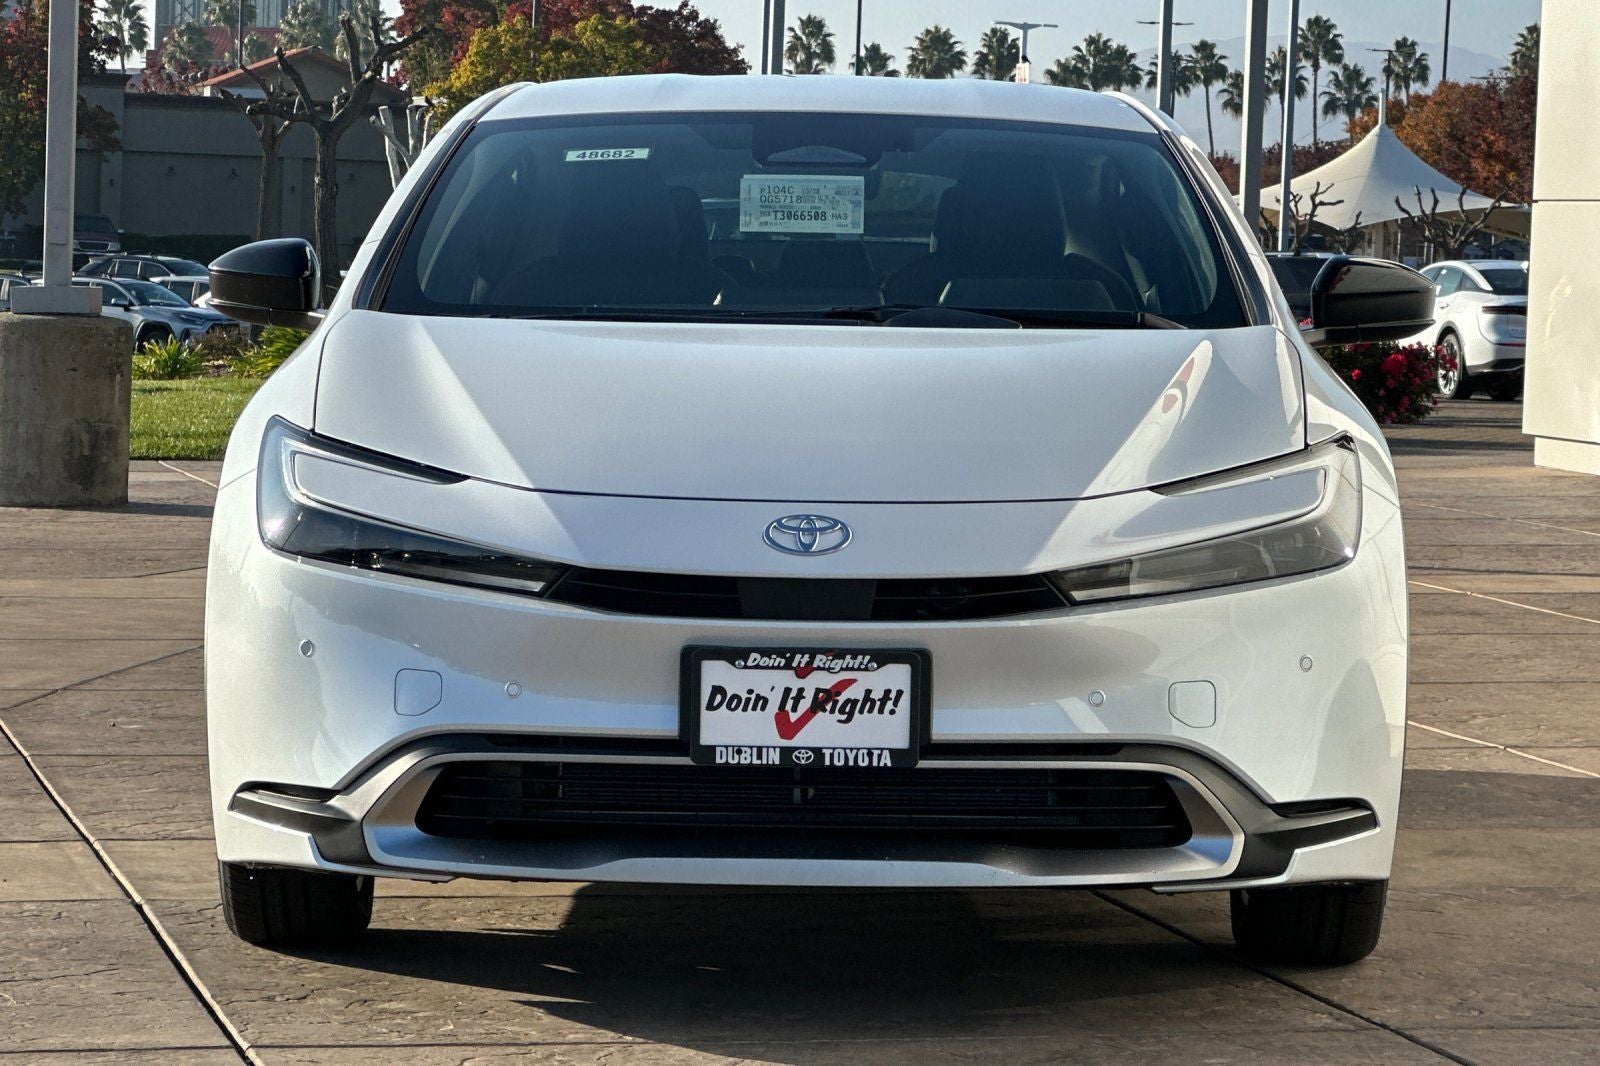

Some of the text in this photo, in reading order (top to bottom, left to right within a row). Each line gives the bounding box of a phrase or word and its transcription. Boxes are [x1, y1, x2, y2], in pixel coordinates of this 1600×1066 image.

[575, 150, 635, 159] 48682
[773, 210, 827, 221] T3066508
[746, 652, 871, 673] Doin' It Right!
[705, 685, 904, 724] Doin' It Right!
[715, 746, 892, 767] DUBLIN TOYOTA
